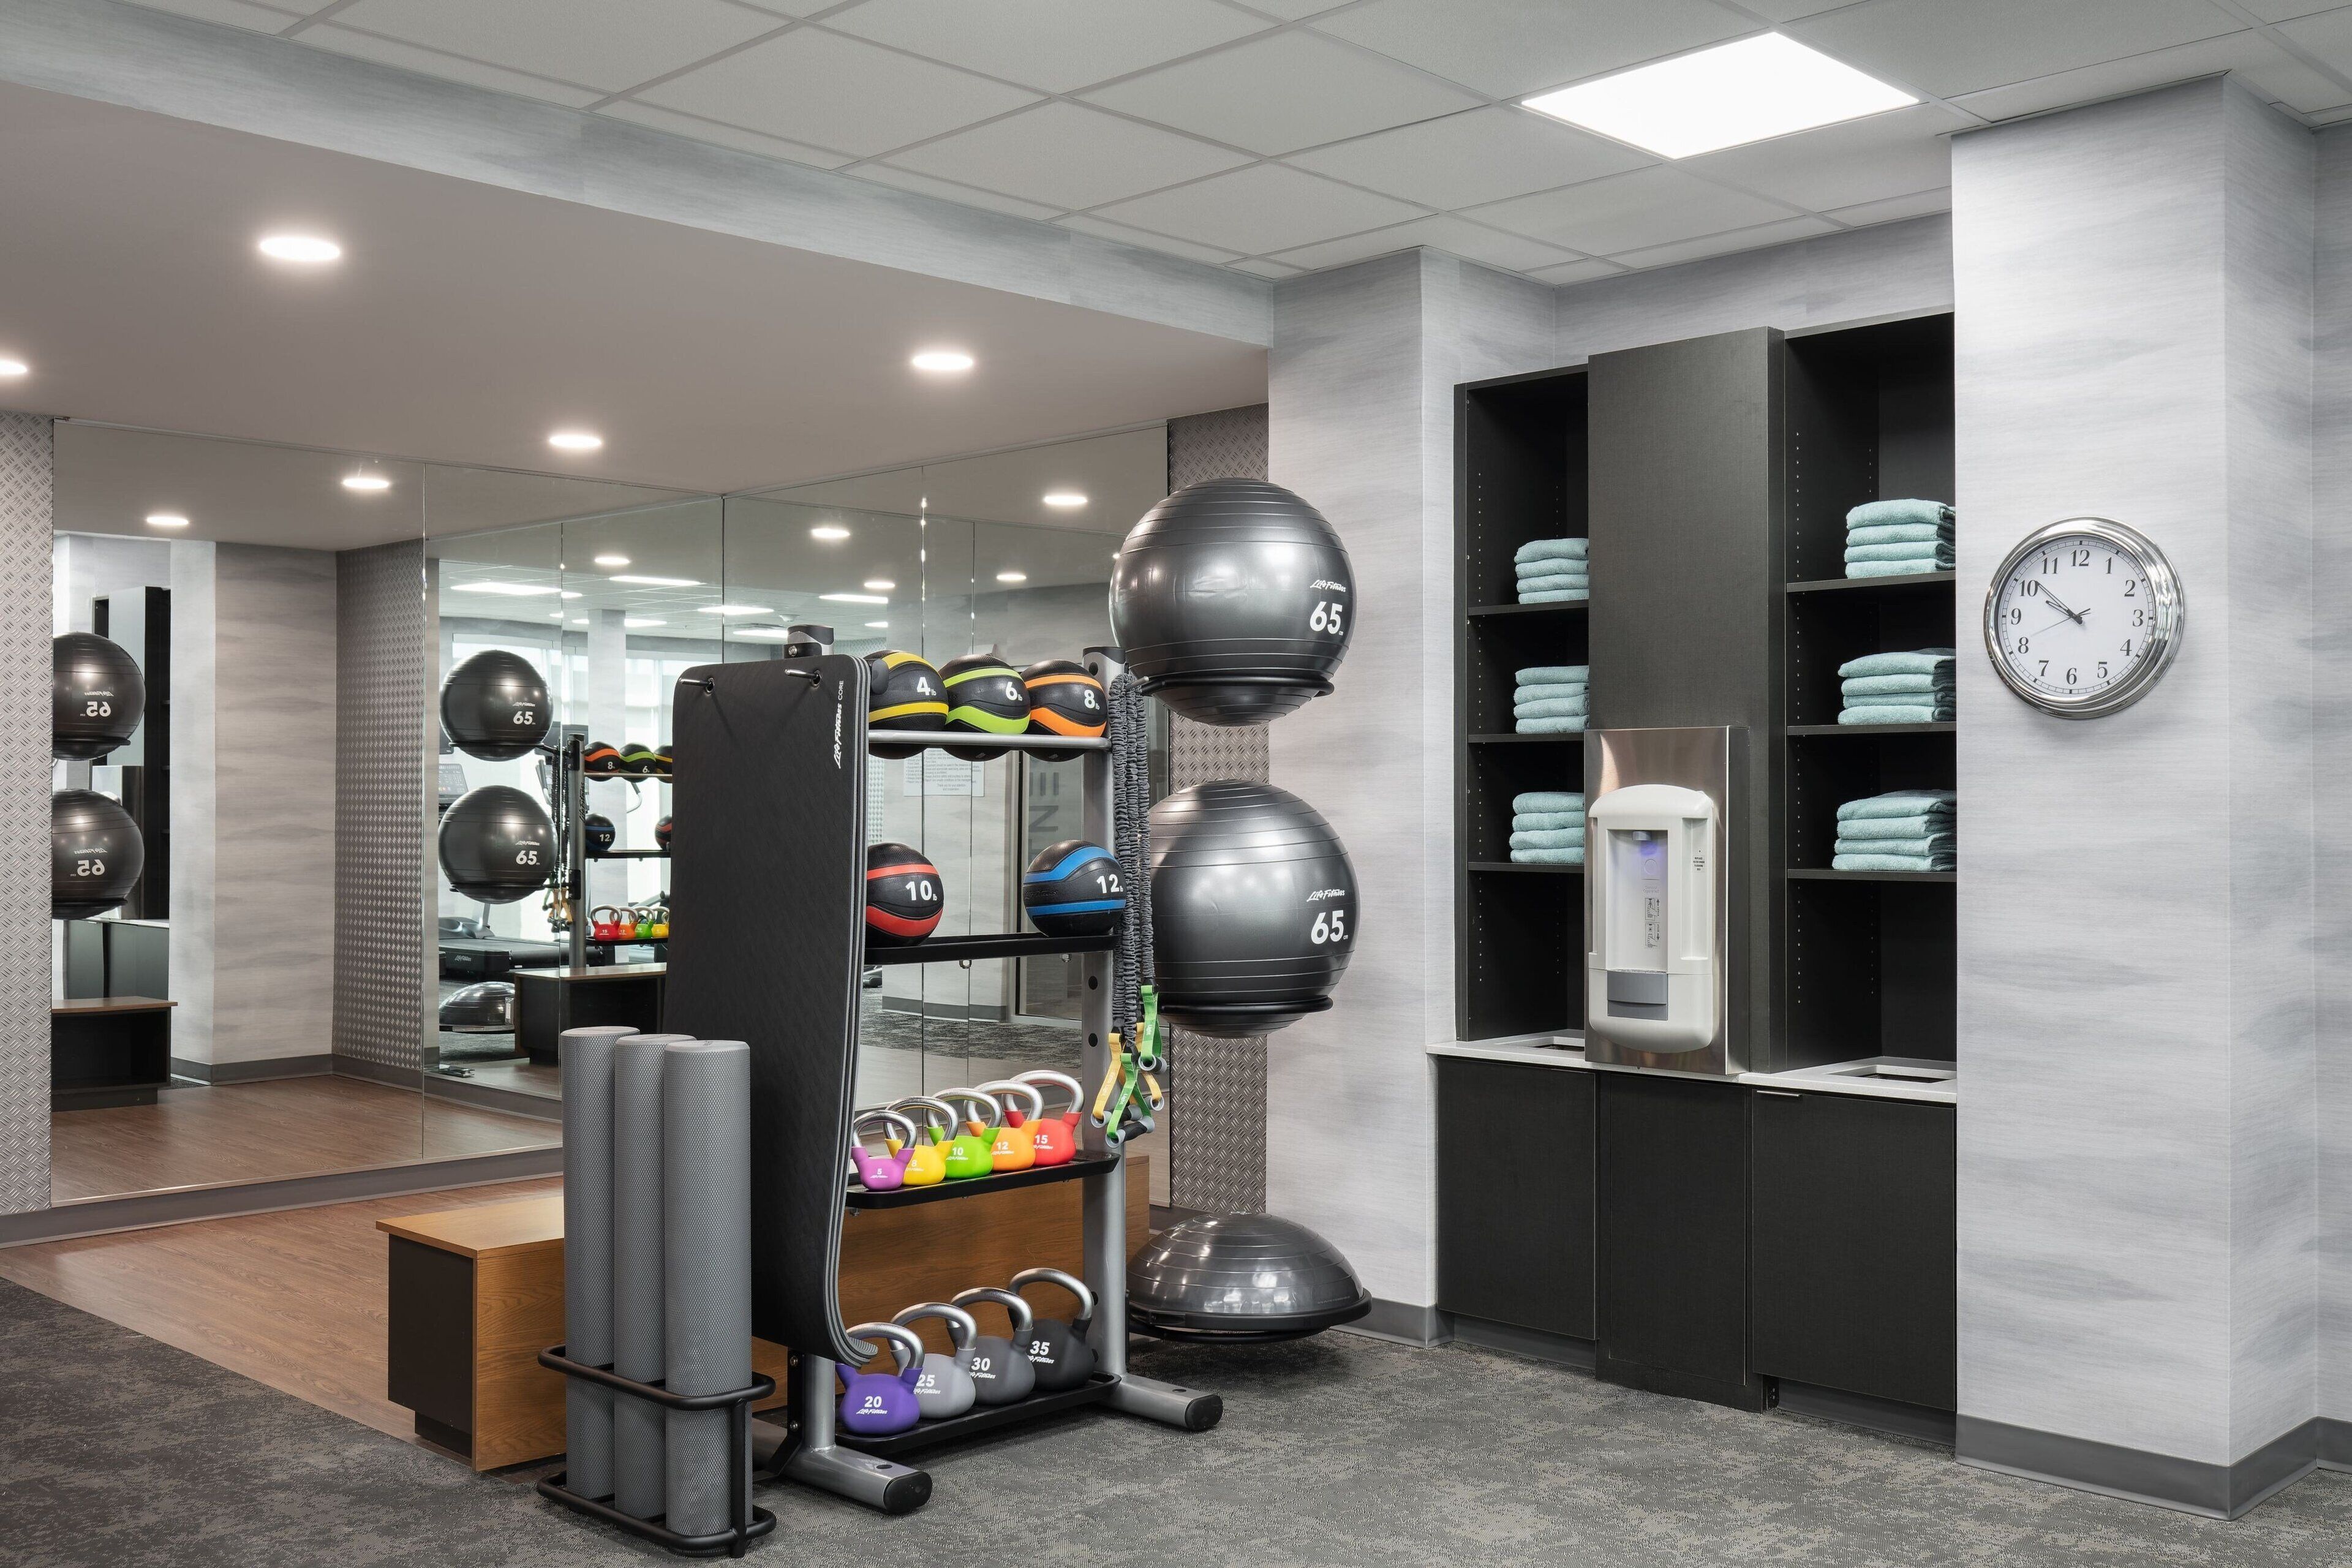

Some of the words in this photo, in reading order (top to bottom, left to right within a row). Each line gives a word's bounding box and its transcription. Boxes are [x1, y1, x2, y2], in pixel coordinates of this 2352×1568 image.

[2041, 557, 2058, 574] 11
[2070, 549, 2090, 567] 12
[2106, 557, 2112, 574] 1
[2019, 579, 2039, 597] 10
[2124, 579, 2136, 597] 2
[1310, 601, 1343, 634] 65
[2011, 608, 2021, 625] 9
[2132, 609, 2143, 627] 3
[2018, 636, 2029, 654] 8
[2120, 639, 2132, 656] 4
[2038, 660, 2049, 676] 7
[2066, 668, 2077, 685] 6
[2097, 662, 2108, 679] 5
[916, 677, 931, 696] 4
[1005, 682, 1018, 701] 6
[1084, 690, 1095, 708] 8
[513, 711, 533, 725] 65
[516, 850, 537, 865] 65
[905, 881, 932, 900] 10
[1096, 874, 1120, 893] 12
[1311, 910, 1344, 944] 65
[997, 1142, 1009, 1150] 12
[1035, 1134, 1048, 1144] 15
[952, 1147, 963, 1156] 10
[1030, 1340, 1050, 1355] 35
[971, 1357, 990, 1371] 30
[916, 1374, 935, 1387] 25
[864, 1396, 882, 1408] 20
